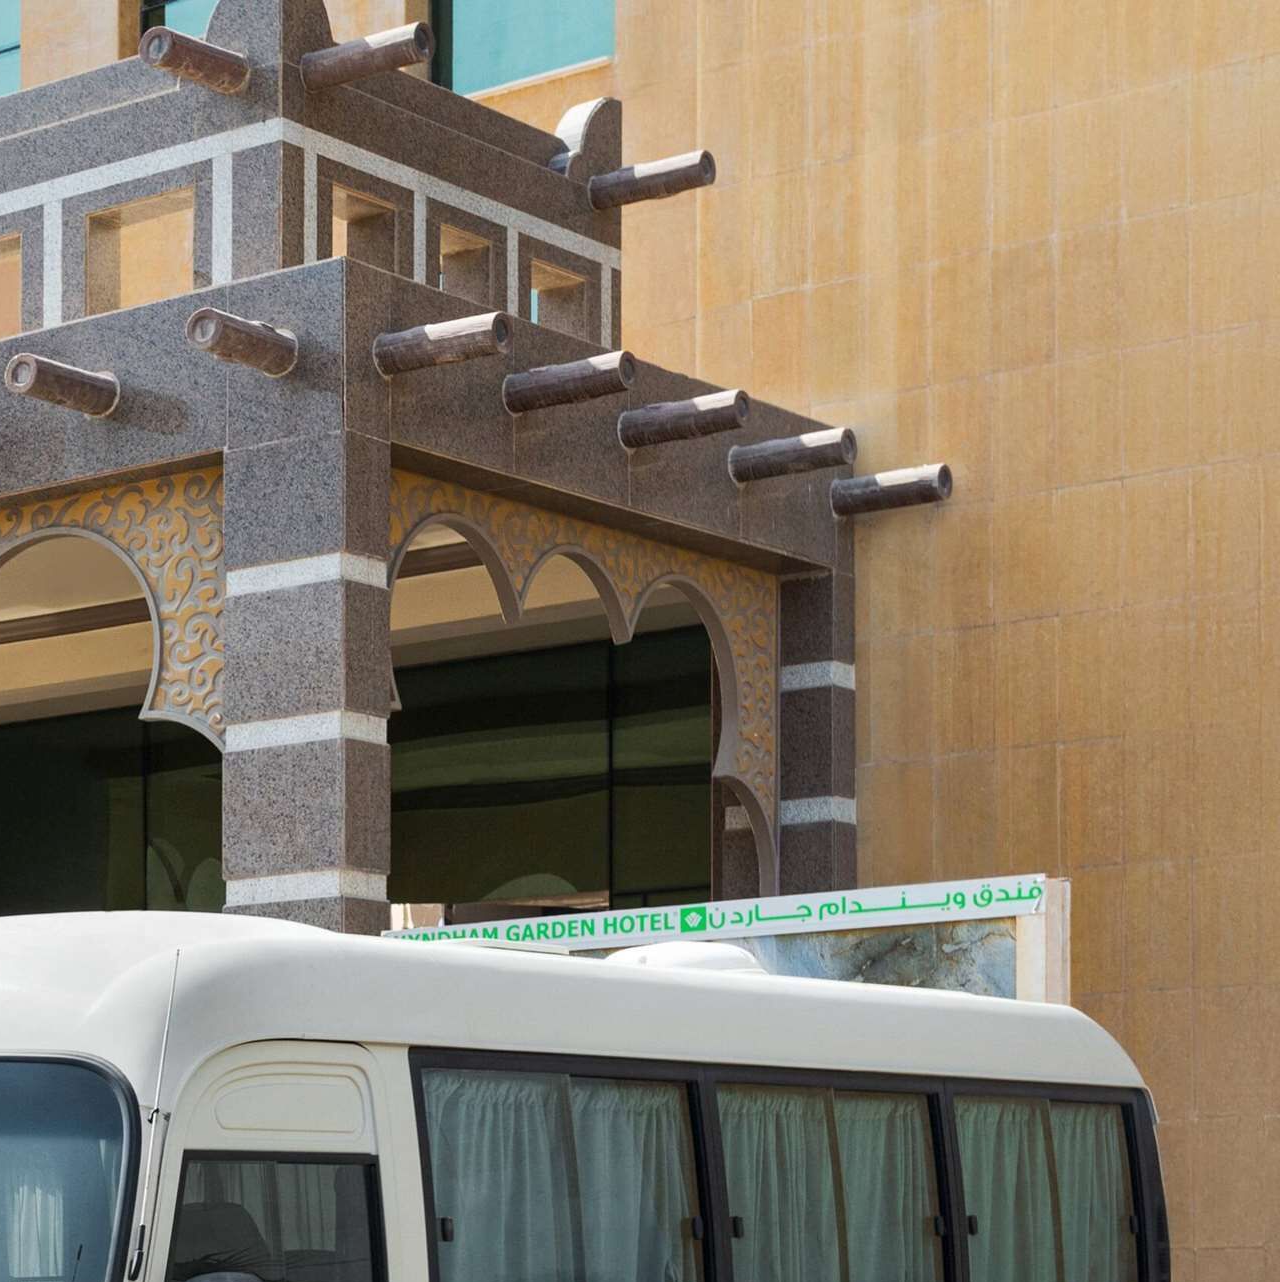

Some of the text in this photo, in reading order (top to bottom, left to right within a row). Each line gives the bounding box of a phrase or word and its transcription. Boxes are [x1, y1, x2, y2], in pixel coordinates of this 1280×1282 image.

[973, 878, 1043, 907] فندق
[506, 918, 595, 942] GARDEN
[602, 911, 676, 934] HOTEL
